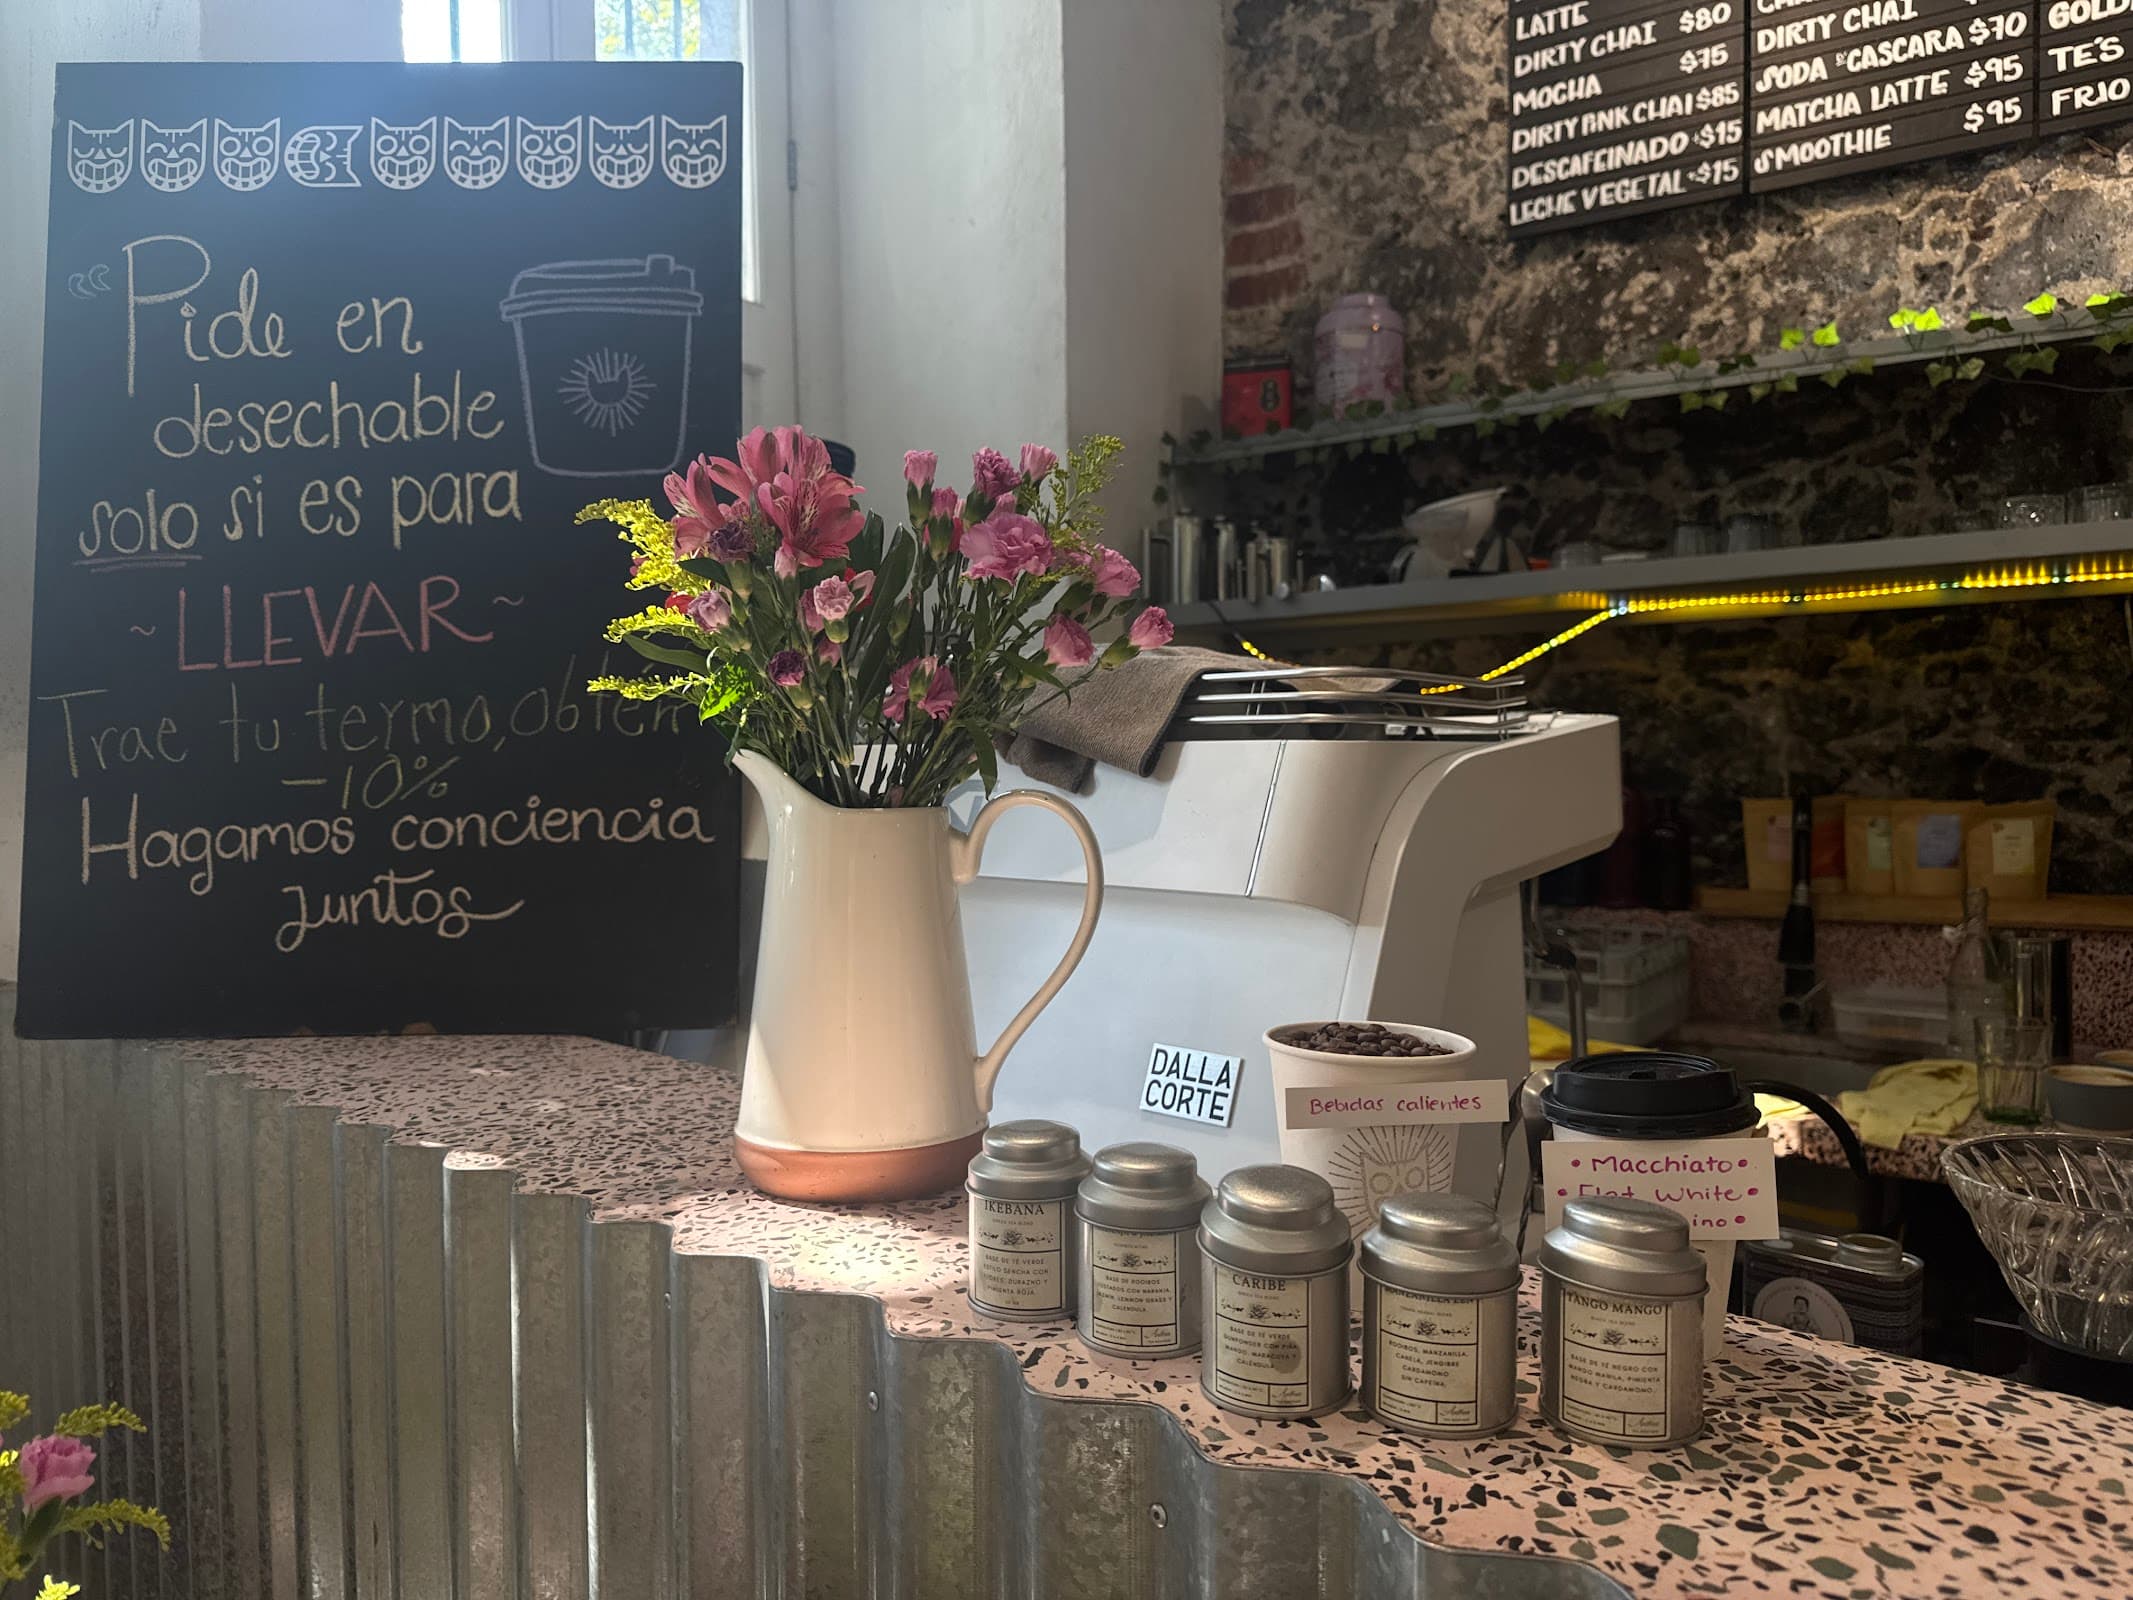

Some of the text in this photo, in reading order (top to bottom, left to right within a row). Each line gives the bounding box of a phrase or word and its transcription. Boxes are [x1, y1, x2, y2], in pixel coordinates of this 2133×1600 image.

[1514, 2, 1732, 78] DIRTY CHAI $80
[1515, 1, 1589, 41] LATTE
[1756, 0, 1918, 53] DIRTY CHAI
[2048, 0, 2133, 30] GOLD
[1512, 43, 1730, 116] MOCHA $75
[1755, 56, 1828, 93] SODA
[1968, 11, 2028, 46] $70
[1512, 115, 1580, 154] DIRTY
[1632, 92, 1693, 125] CHAI
[1695, 81, 1740, 111] $85
[1755, 54, 2024, 135] MATCHA LATTE $95
[2051, 78, 2131, 117] FRIO
[1511, 130, 1690, 190] DESCAFEINADO
[1753, 96, 2022, 174] SMOOTHIE $95
[1509, 189, 1577, 227] LECHE
[1580, 168, 1688, 210] VEGETAL
[121, 233, 424, 398] Pide en
[153, 369, 506, 459] desechable
[79, 468, 523, 558] solo si es para
[178, 574, 494, 671] LLEVAR
[37, 687, 190, 780] Trae
[218, 681, 280, 765] tu
[80, 792, 716, 897] Hagamos conciencia
[1151, 1048, 1230, 1089] DALLA
[1145, 1079, 1229, 1121] CORTE
[1309, 1097, 1385, 1115] Bebidas
[1591, 1154, 1733, 1174] Macchiato
[984, 1200, 1045, 1215] IKEBANA
[1232, 1273, 1287, 1292] CARIBE
[1566, 1290, 1662, 1315] TANGO MANGO
